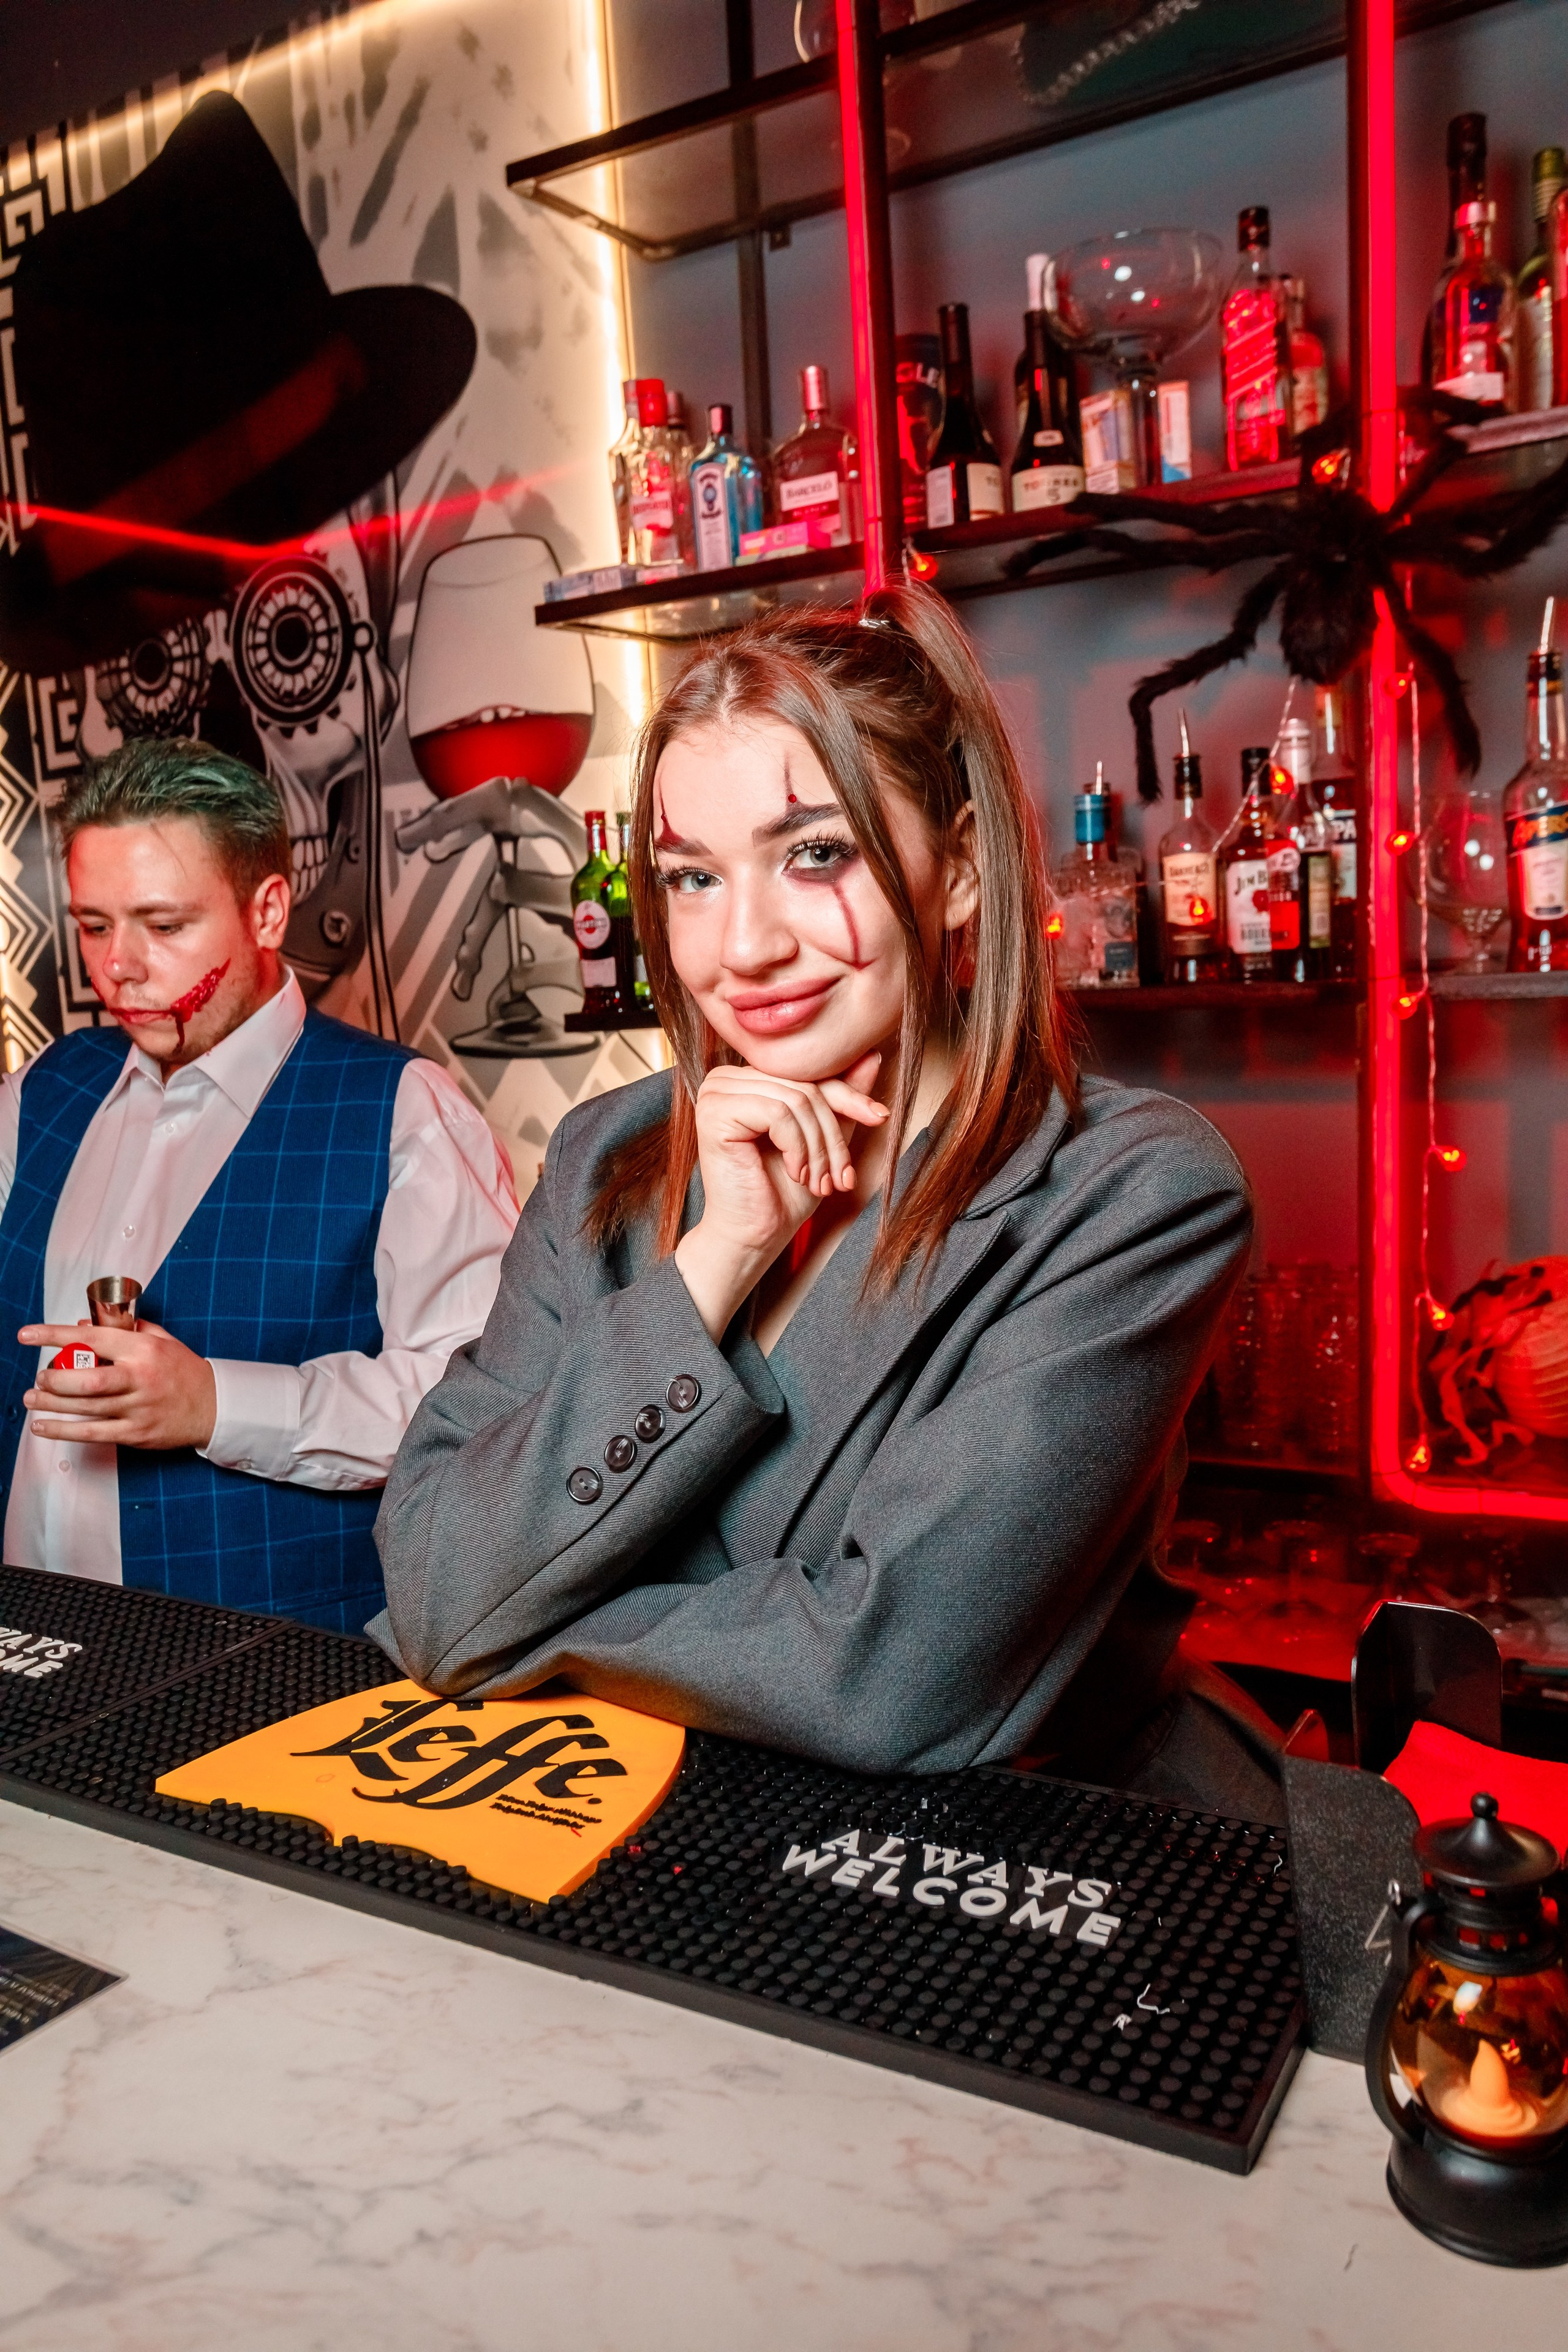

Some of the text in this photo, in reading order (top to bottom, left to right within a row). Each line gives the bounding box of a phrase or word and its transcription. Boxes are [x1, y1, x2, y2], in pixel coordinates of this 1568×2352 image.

[0, 1649, 64, 1678] ME
[782, 1844, 1121, 1947] WELCOME
[821, 1828, 1112, 1908] ALWAYS
